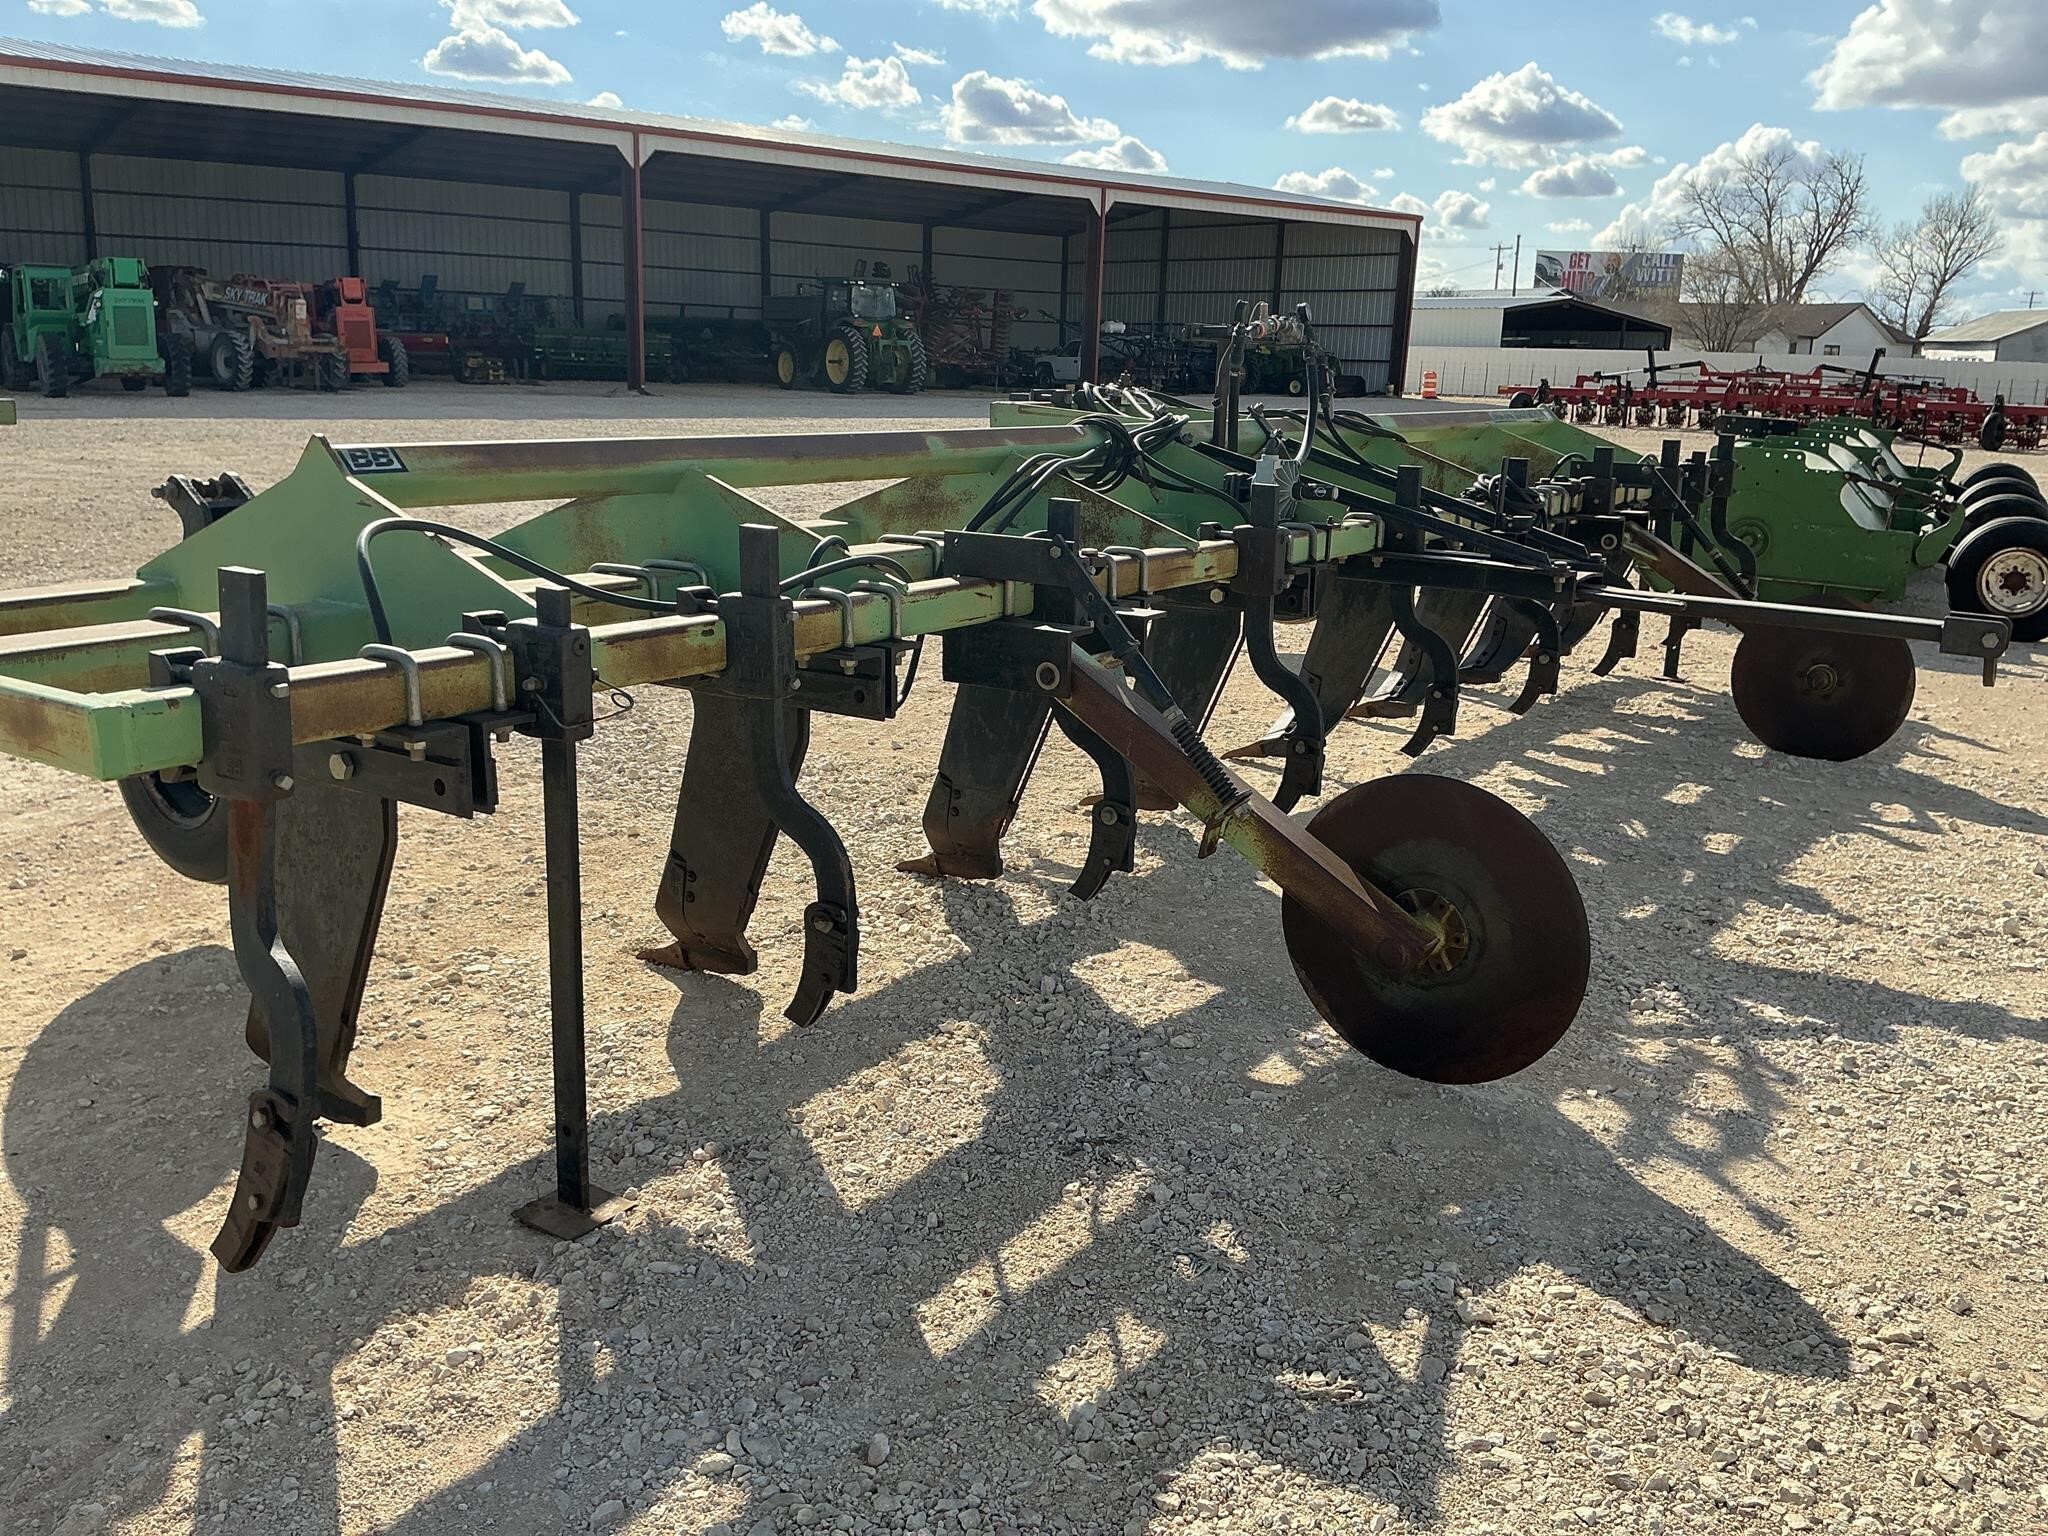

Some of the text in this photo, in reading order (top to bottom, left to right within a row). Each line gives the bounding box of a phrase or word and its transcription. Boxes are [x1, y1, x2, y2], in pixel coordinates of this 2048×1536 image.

[1569, 252, 1591, 270] GET
[1642, 254, 1676, 268] CALL
[1561, 270, 1595, 291] HIT?
[224, 286, 268, 306] SKY TRAK
